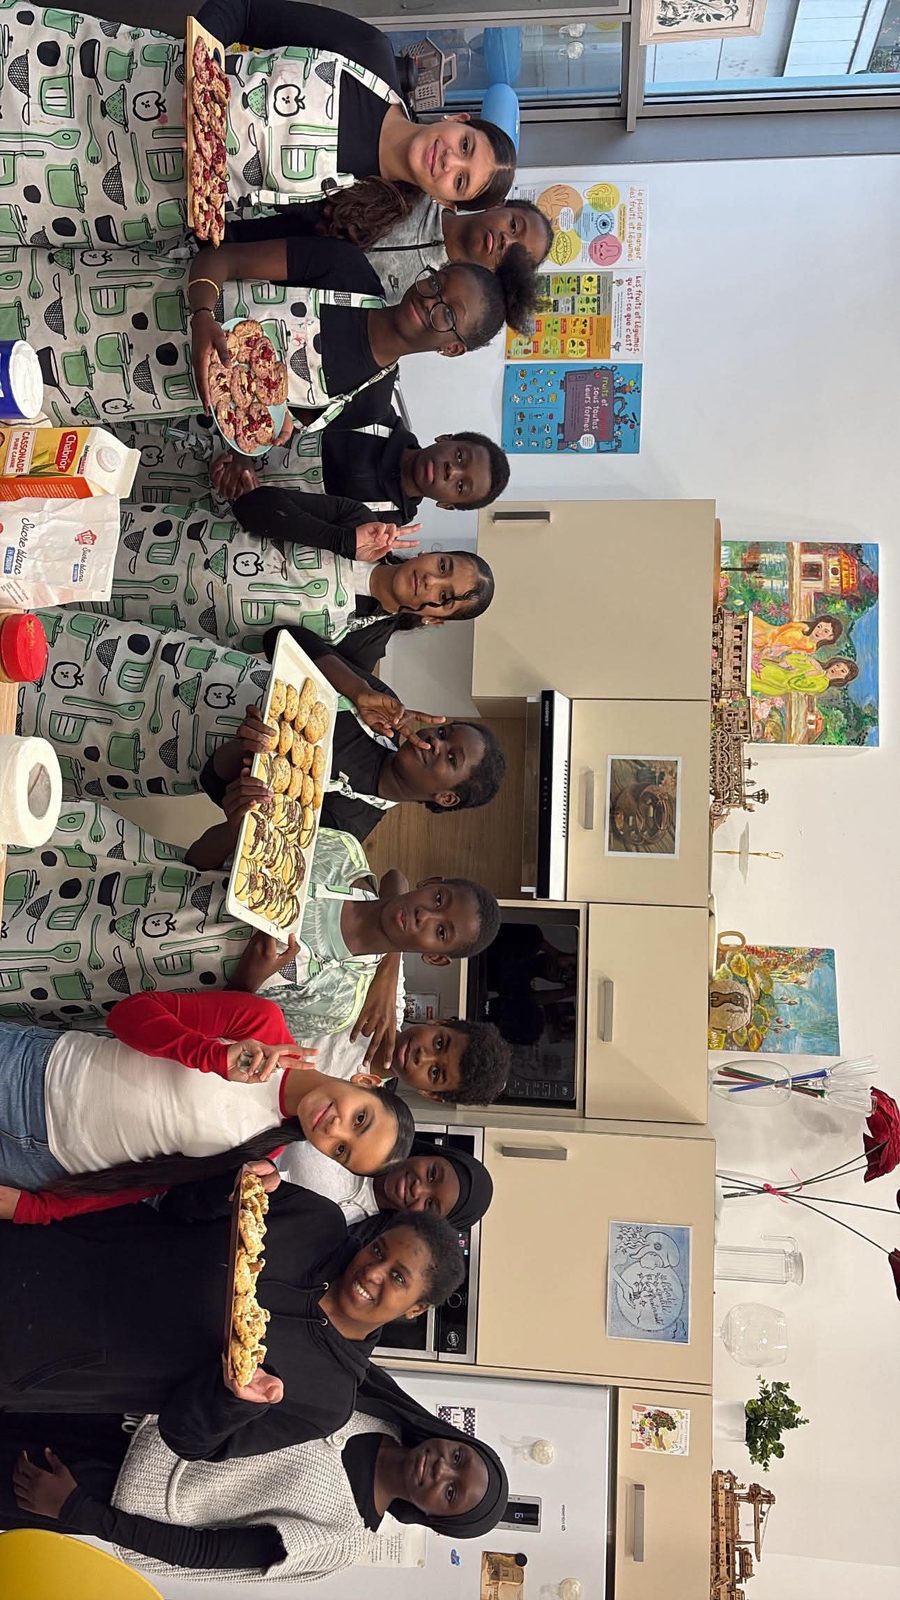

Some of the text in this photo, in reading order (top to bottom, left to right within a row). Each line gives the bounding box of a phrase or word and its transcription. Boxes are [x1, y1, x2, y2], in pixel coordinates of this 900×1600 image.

[629, 222, 635, 230] et
[627, 232, 635, 262] légumes
[602, 399, 608, 407] et
[583, 406, 592, 432] formes
[592, 406, 600, 430] toutes
[15, 431, 30, 472] CASSONADE
[18, 517, 35, 548] Sucre
[81, 531, 93, 545] TOP
[14, 549, 27, 575] blanc
[79, 547, 91, 582] Sucre blanc
